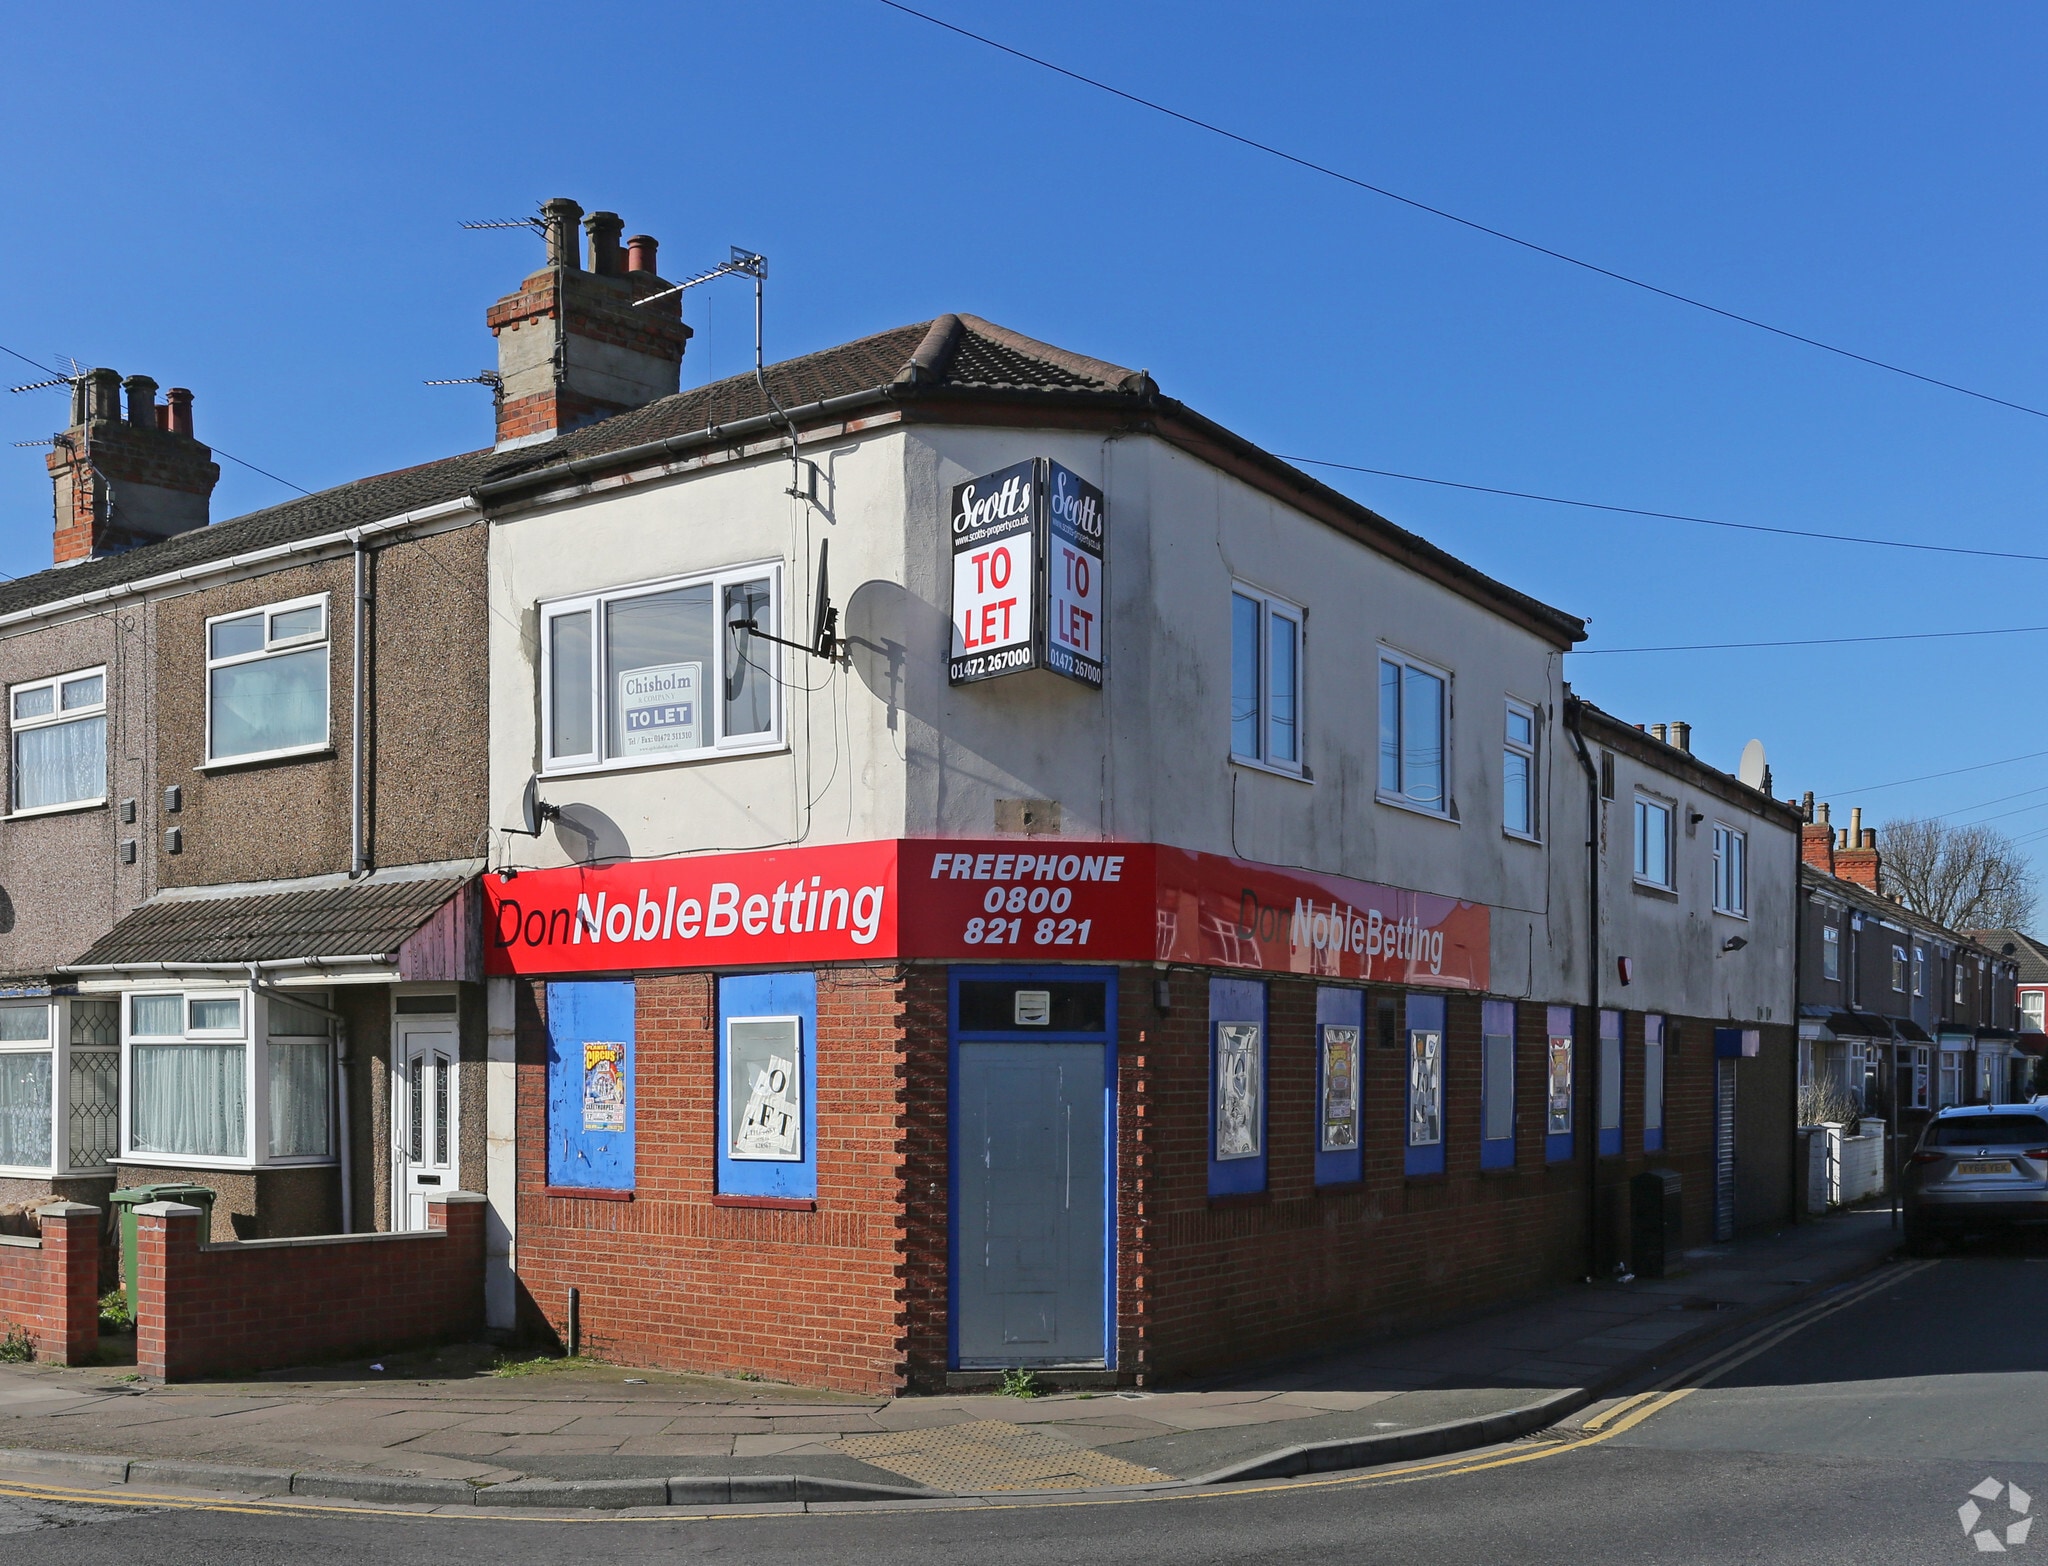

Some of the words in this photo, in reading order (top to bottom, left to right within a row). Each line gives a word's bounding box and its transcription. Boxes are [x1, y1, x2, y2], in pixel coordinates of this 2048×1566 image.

[954, 476, 1031, 533] Scotts
[1053, 471, 1102, 538] Scotts
[955, 514, 1029, 546] www.scotts-property.co.uk
[971, 547, 1012, 594] TO
[1063, 547, 1090, 598] TO
[965, 597, 1017, 649] LET
[1059, 599, 1093, 652] LET
[951, 655, 985, 680] 01472
[987, 647, 1031, 671] 267000
[1051, 649, 1073, 674] 01472
[1075, 660, 1101, 684] 267000
[626, 672, 691, 696] Chisholm
[630, 711, 651, 728] TO
[654, 706, 688, 725] LET
[930, 853, 1124, 881] FREEPHONE
[983, 886, 1072, 912] 0800
[963, 916, 1020, 945] 821
[1033, 916, 1091, 945] 821
[586, 1050, 616, 1070] CIRCUS
